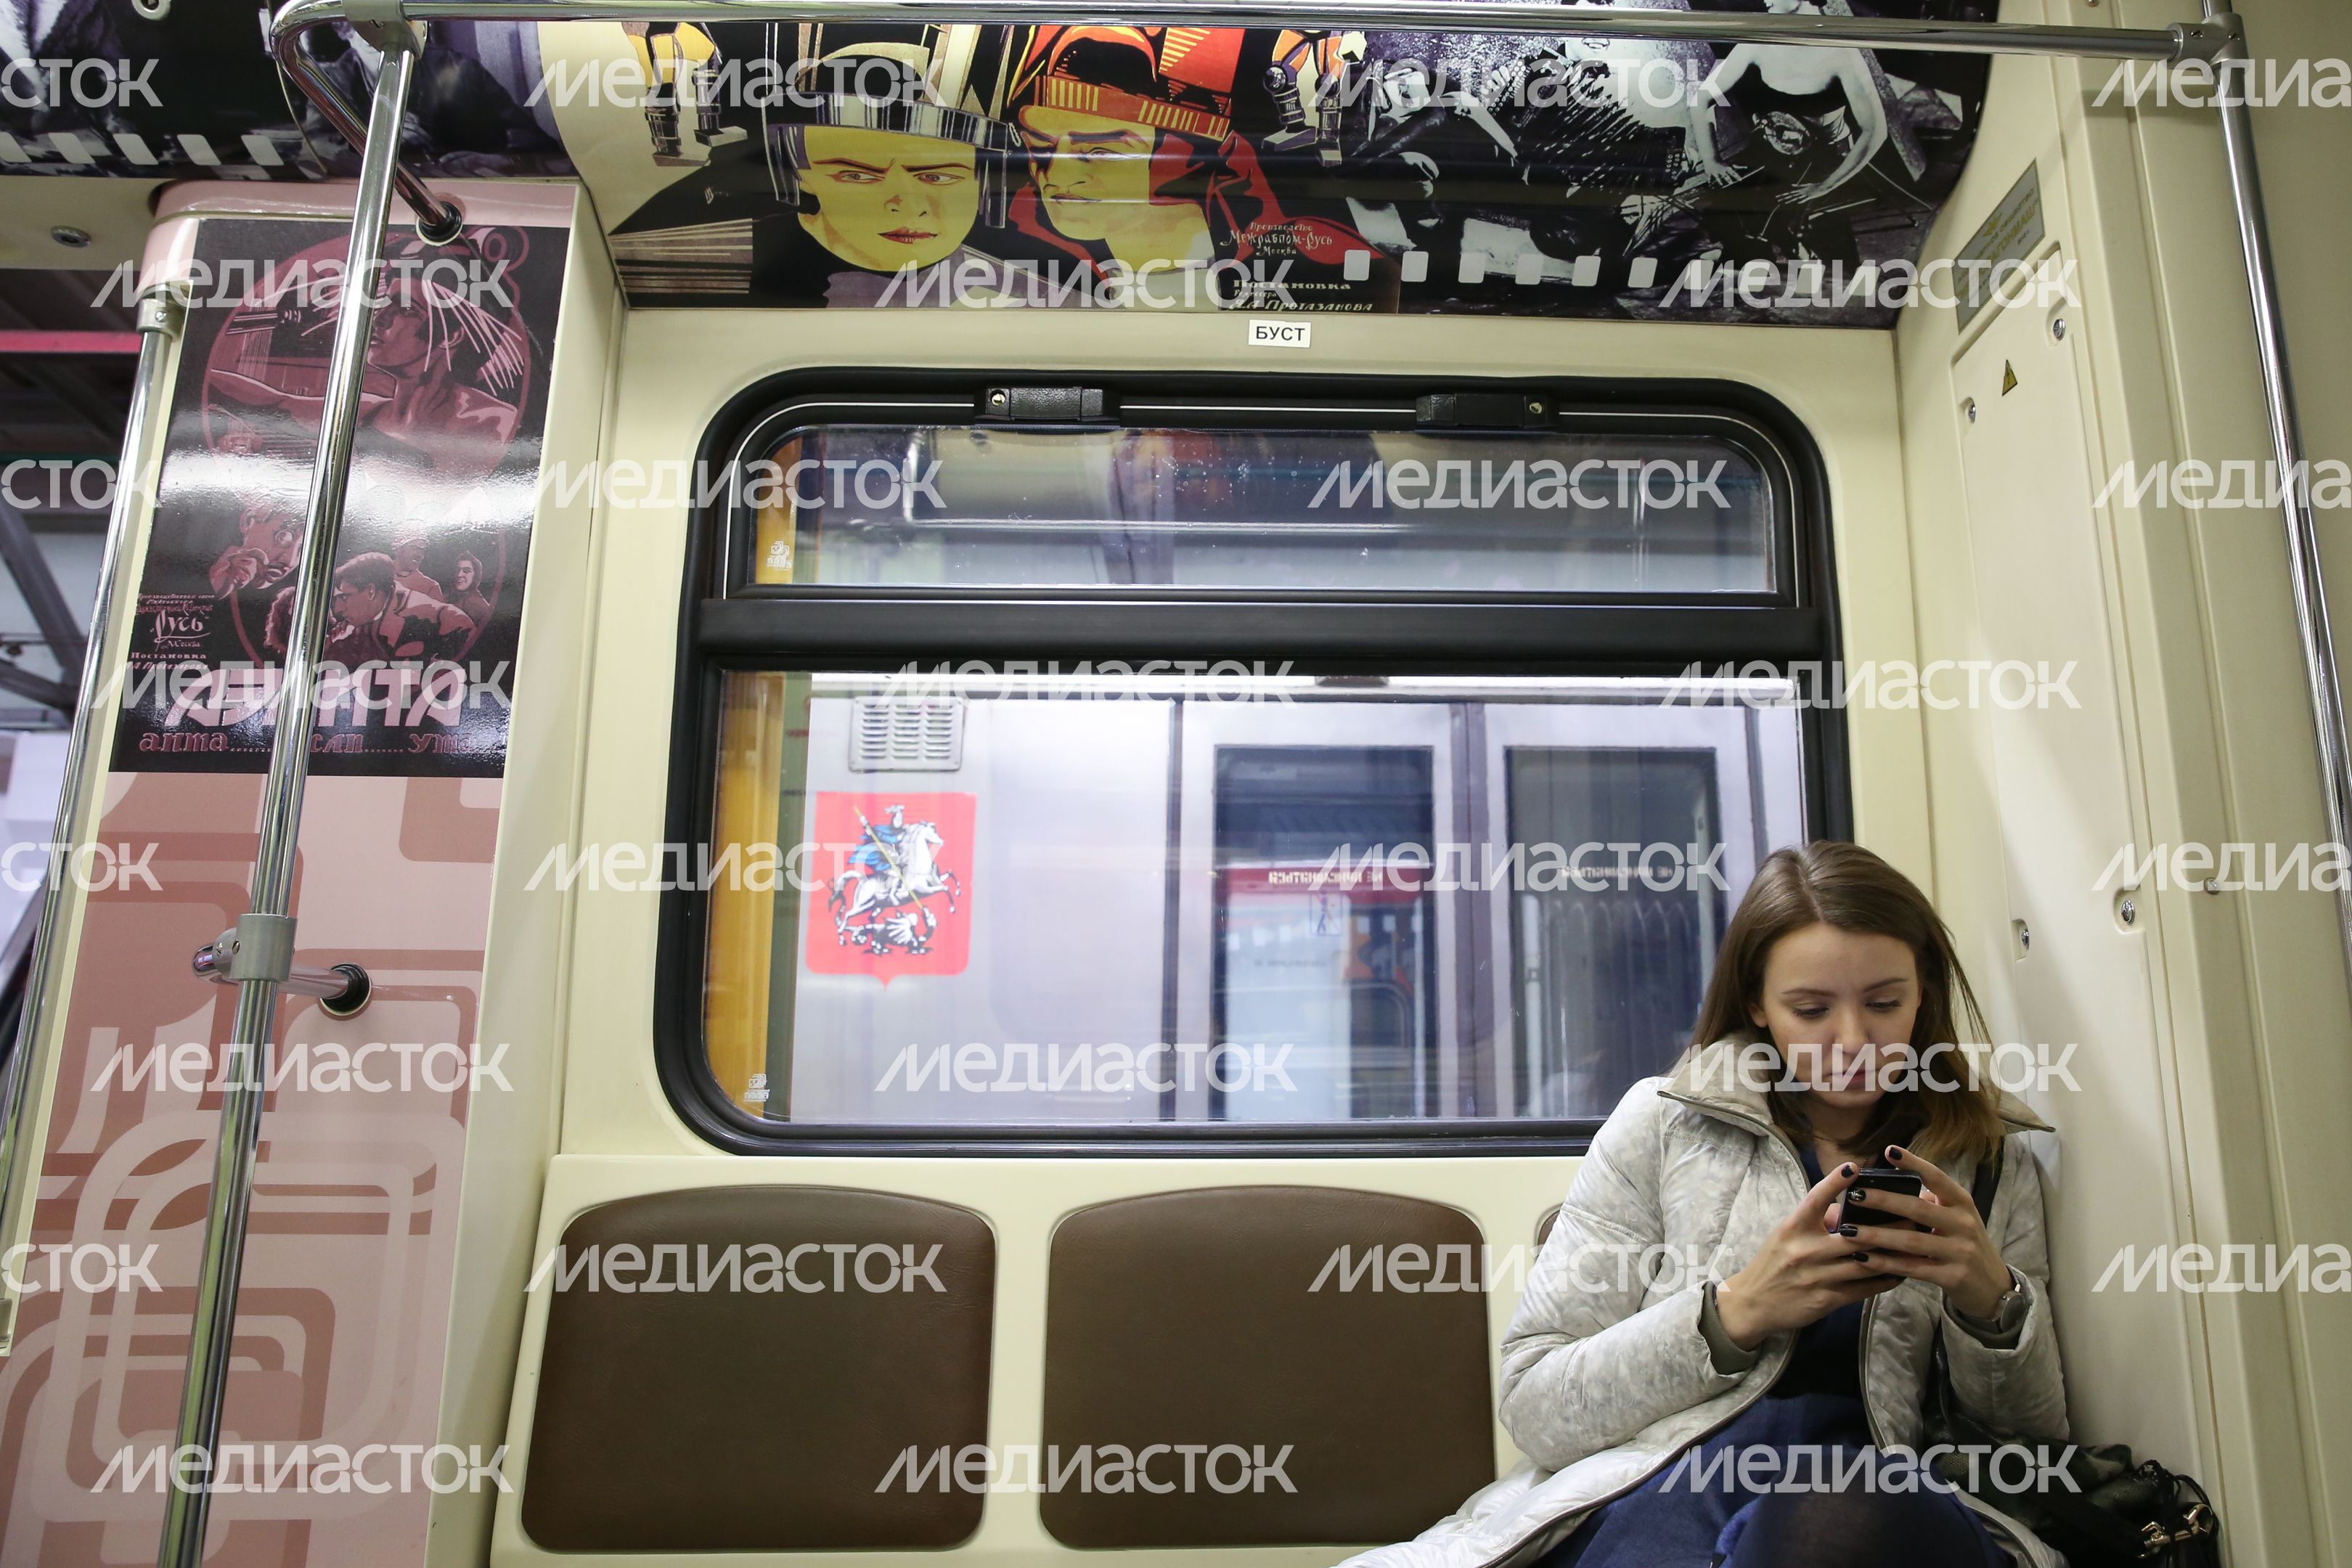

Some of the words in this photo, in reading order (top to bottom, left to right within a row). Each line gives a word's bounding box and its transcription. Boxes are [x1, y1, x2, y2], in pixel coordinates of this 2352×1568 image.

[1256, 246, 1297, 256] Москва
[1233, 279, 1351, 290] Постановка
[1256, 325, 1305, 341] БУСТ
